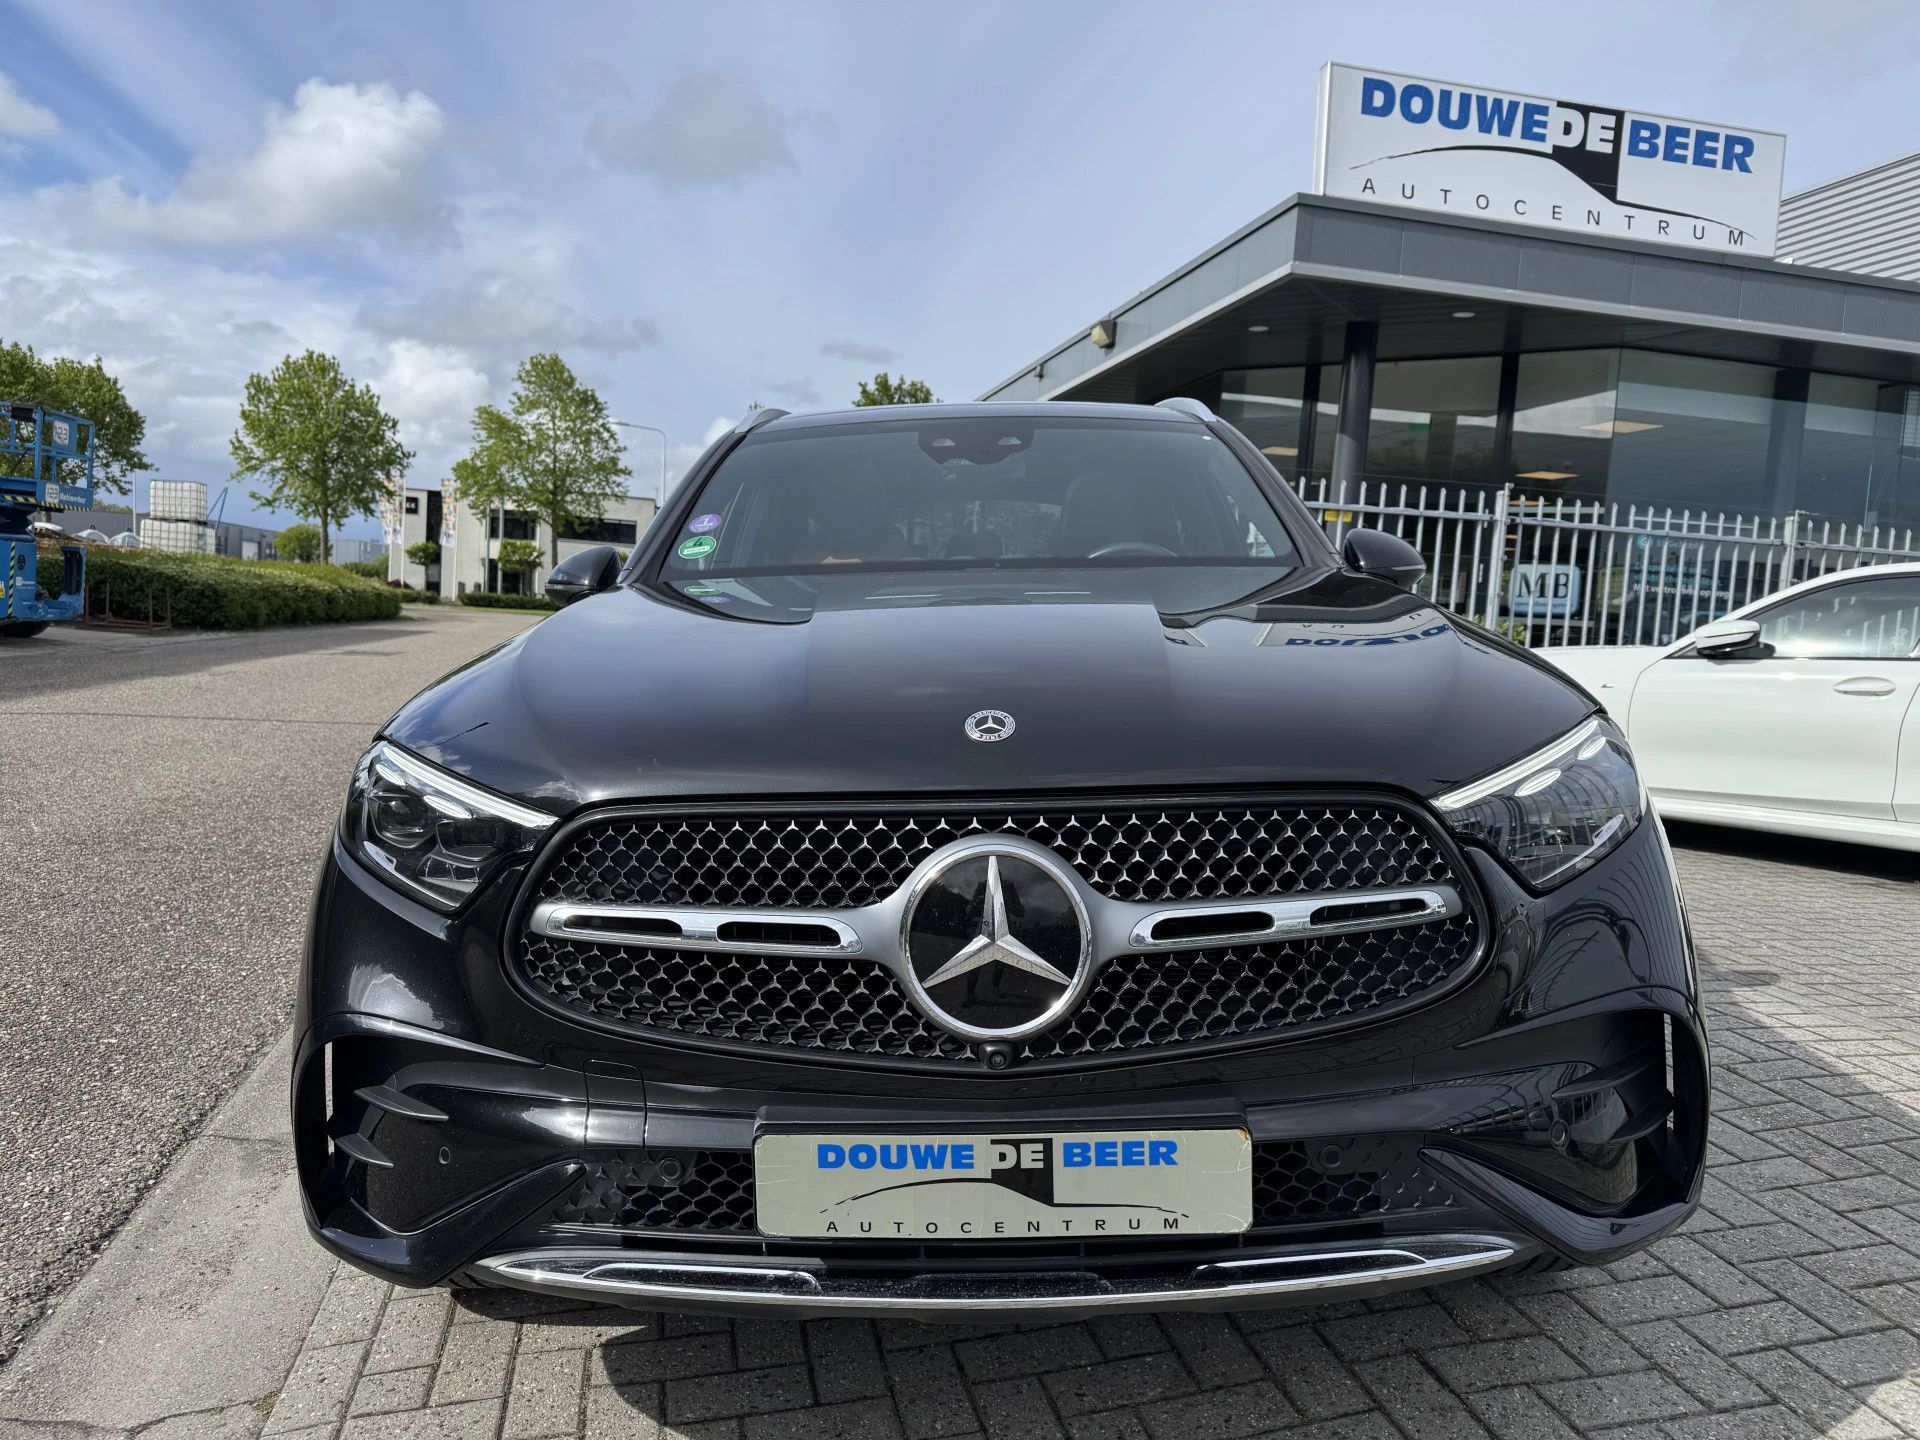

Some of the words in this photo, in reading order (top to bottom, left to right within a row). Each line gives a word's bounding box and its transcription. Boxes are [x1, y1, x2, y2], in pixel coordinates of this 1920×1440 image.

[1361, 76, 1551, 143] DOUWE
[1551, 107, 1617, 154] DE
[1627, 119, 1755, 174] BEER
[1361, 178, 1744, 246] AUTOCENTRUM
[1515, 572, 1570, 599] MB
[1633, 583, 1650, 592] Mt
[1700, 589, 1712, 598] op
[817, 1143, 975, 1170] DOUWE
[990, 1143, 1044, 1169] DE
[1062, 1140, 1178, 1168] BEER
[826, 1217, 1179, 1234] AUTOCENTRUM
